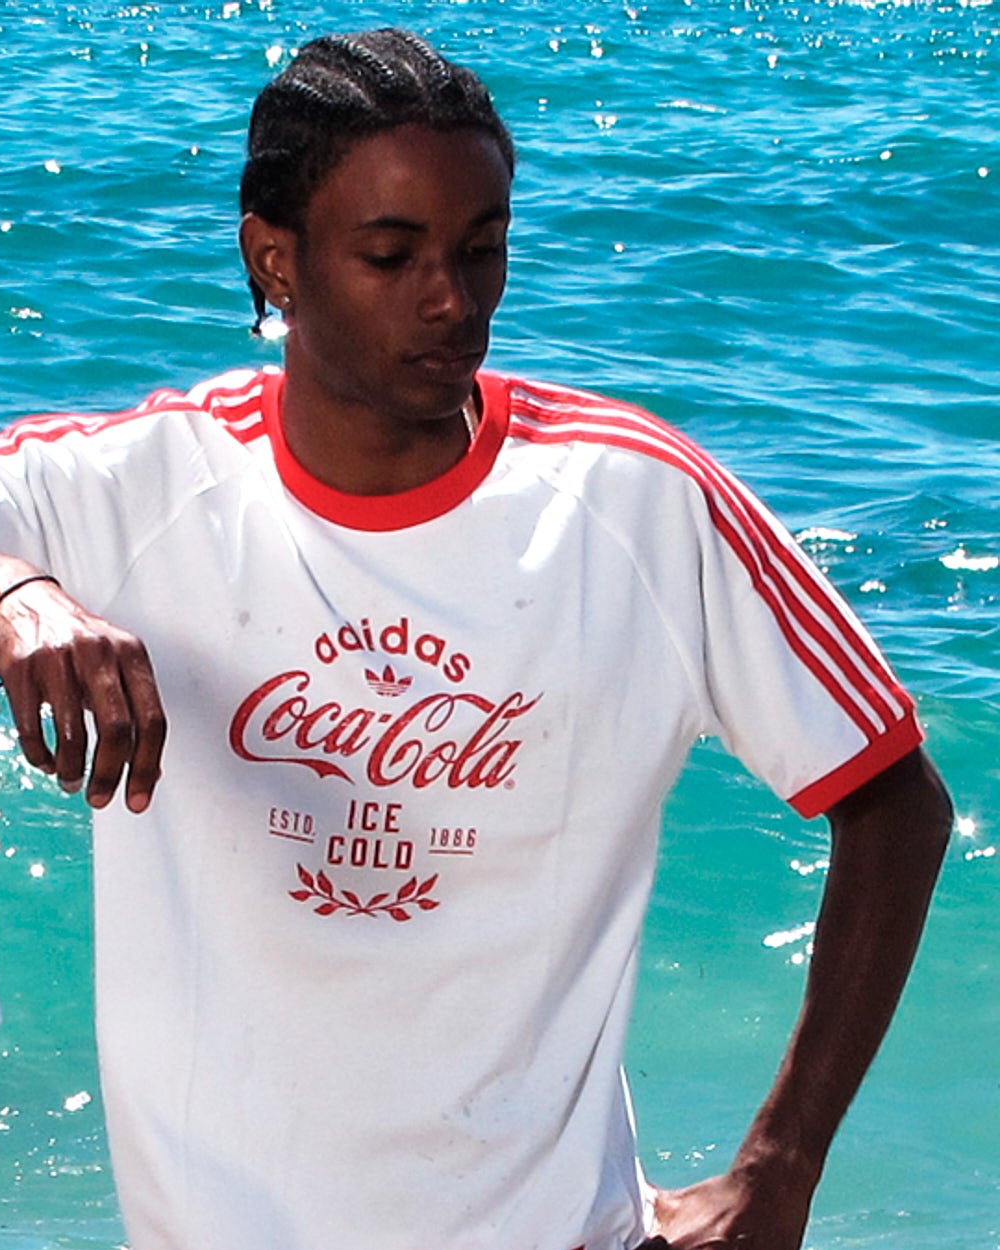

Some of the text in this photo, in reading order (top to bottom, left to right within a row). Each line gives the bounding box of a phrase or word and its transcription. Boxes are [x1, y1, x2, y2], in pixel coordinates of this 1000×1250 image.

[315, 617, 471, 683] adidas
[229, 669, 545, 789] Coca-Cola
[347, 799, 403, 833] ICE
[326, 835, 415, 870] COLD
[429, 827, 477, 849] 1886
